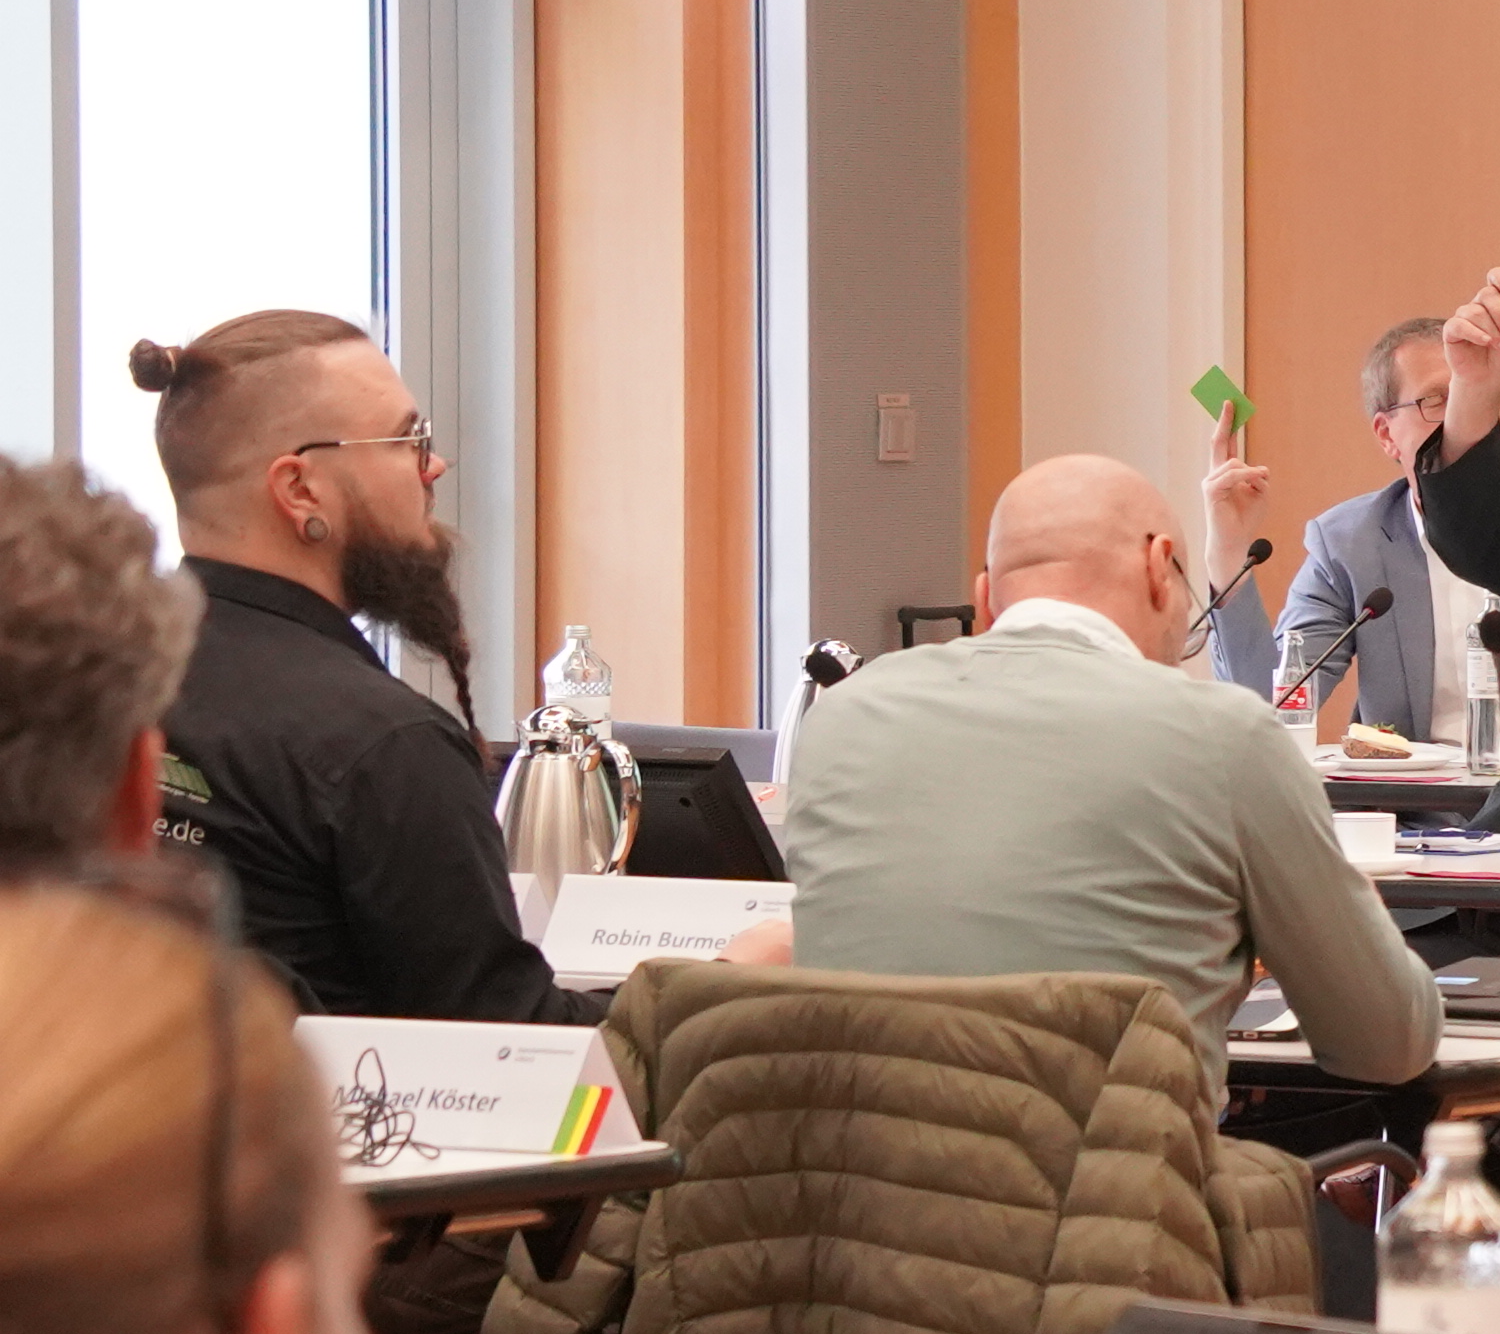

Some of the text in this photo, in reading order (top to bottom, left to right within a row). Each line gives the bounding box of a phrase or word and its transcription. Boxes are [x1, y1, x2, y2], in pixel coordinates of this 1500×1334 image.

[151, 816, 206, 846] e.de
[591, 928, 652, 948] Robin
[426, 1087, 502, 1112] Köster
